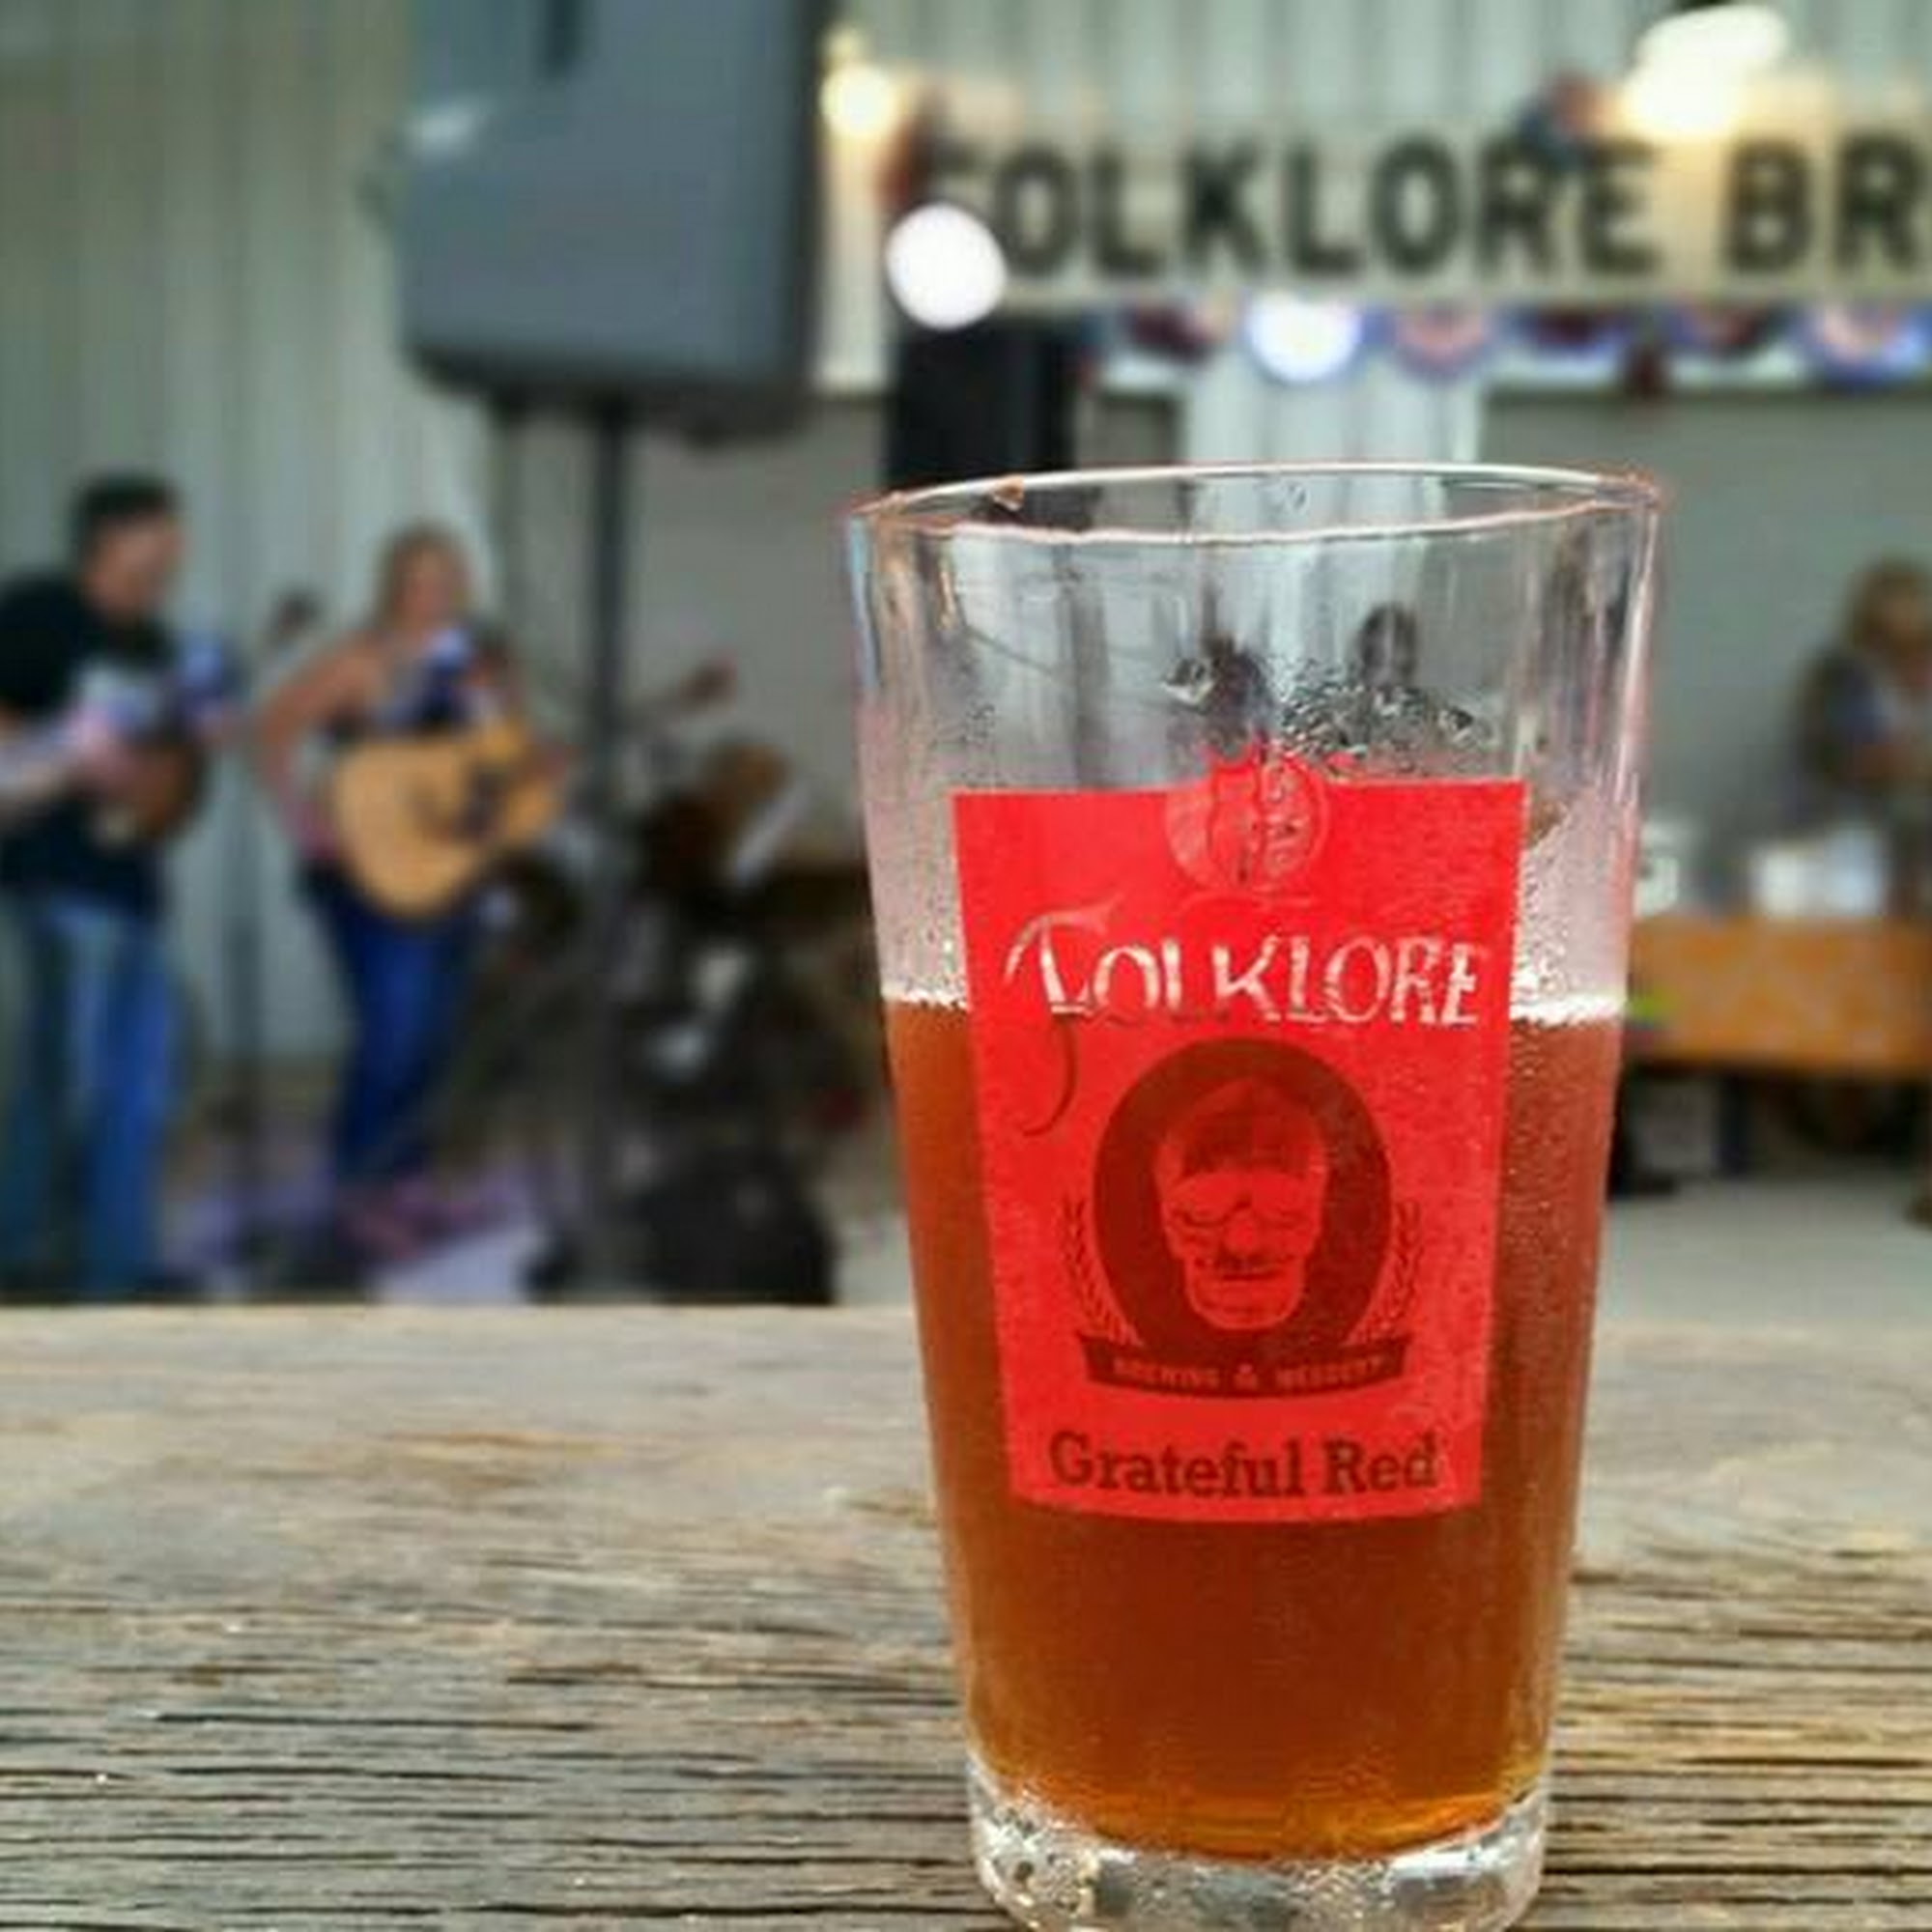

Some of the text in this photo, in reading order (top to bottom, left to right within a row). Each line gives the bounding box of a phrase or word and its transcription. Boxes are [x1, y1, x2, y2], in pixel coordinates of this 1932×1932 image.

[1003, 891, 1485, 1137] FOLKLORE
[1048, 1431, 1438, 1497] Grateful Red
